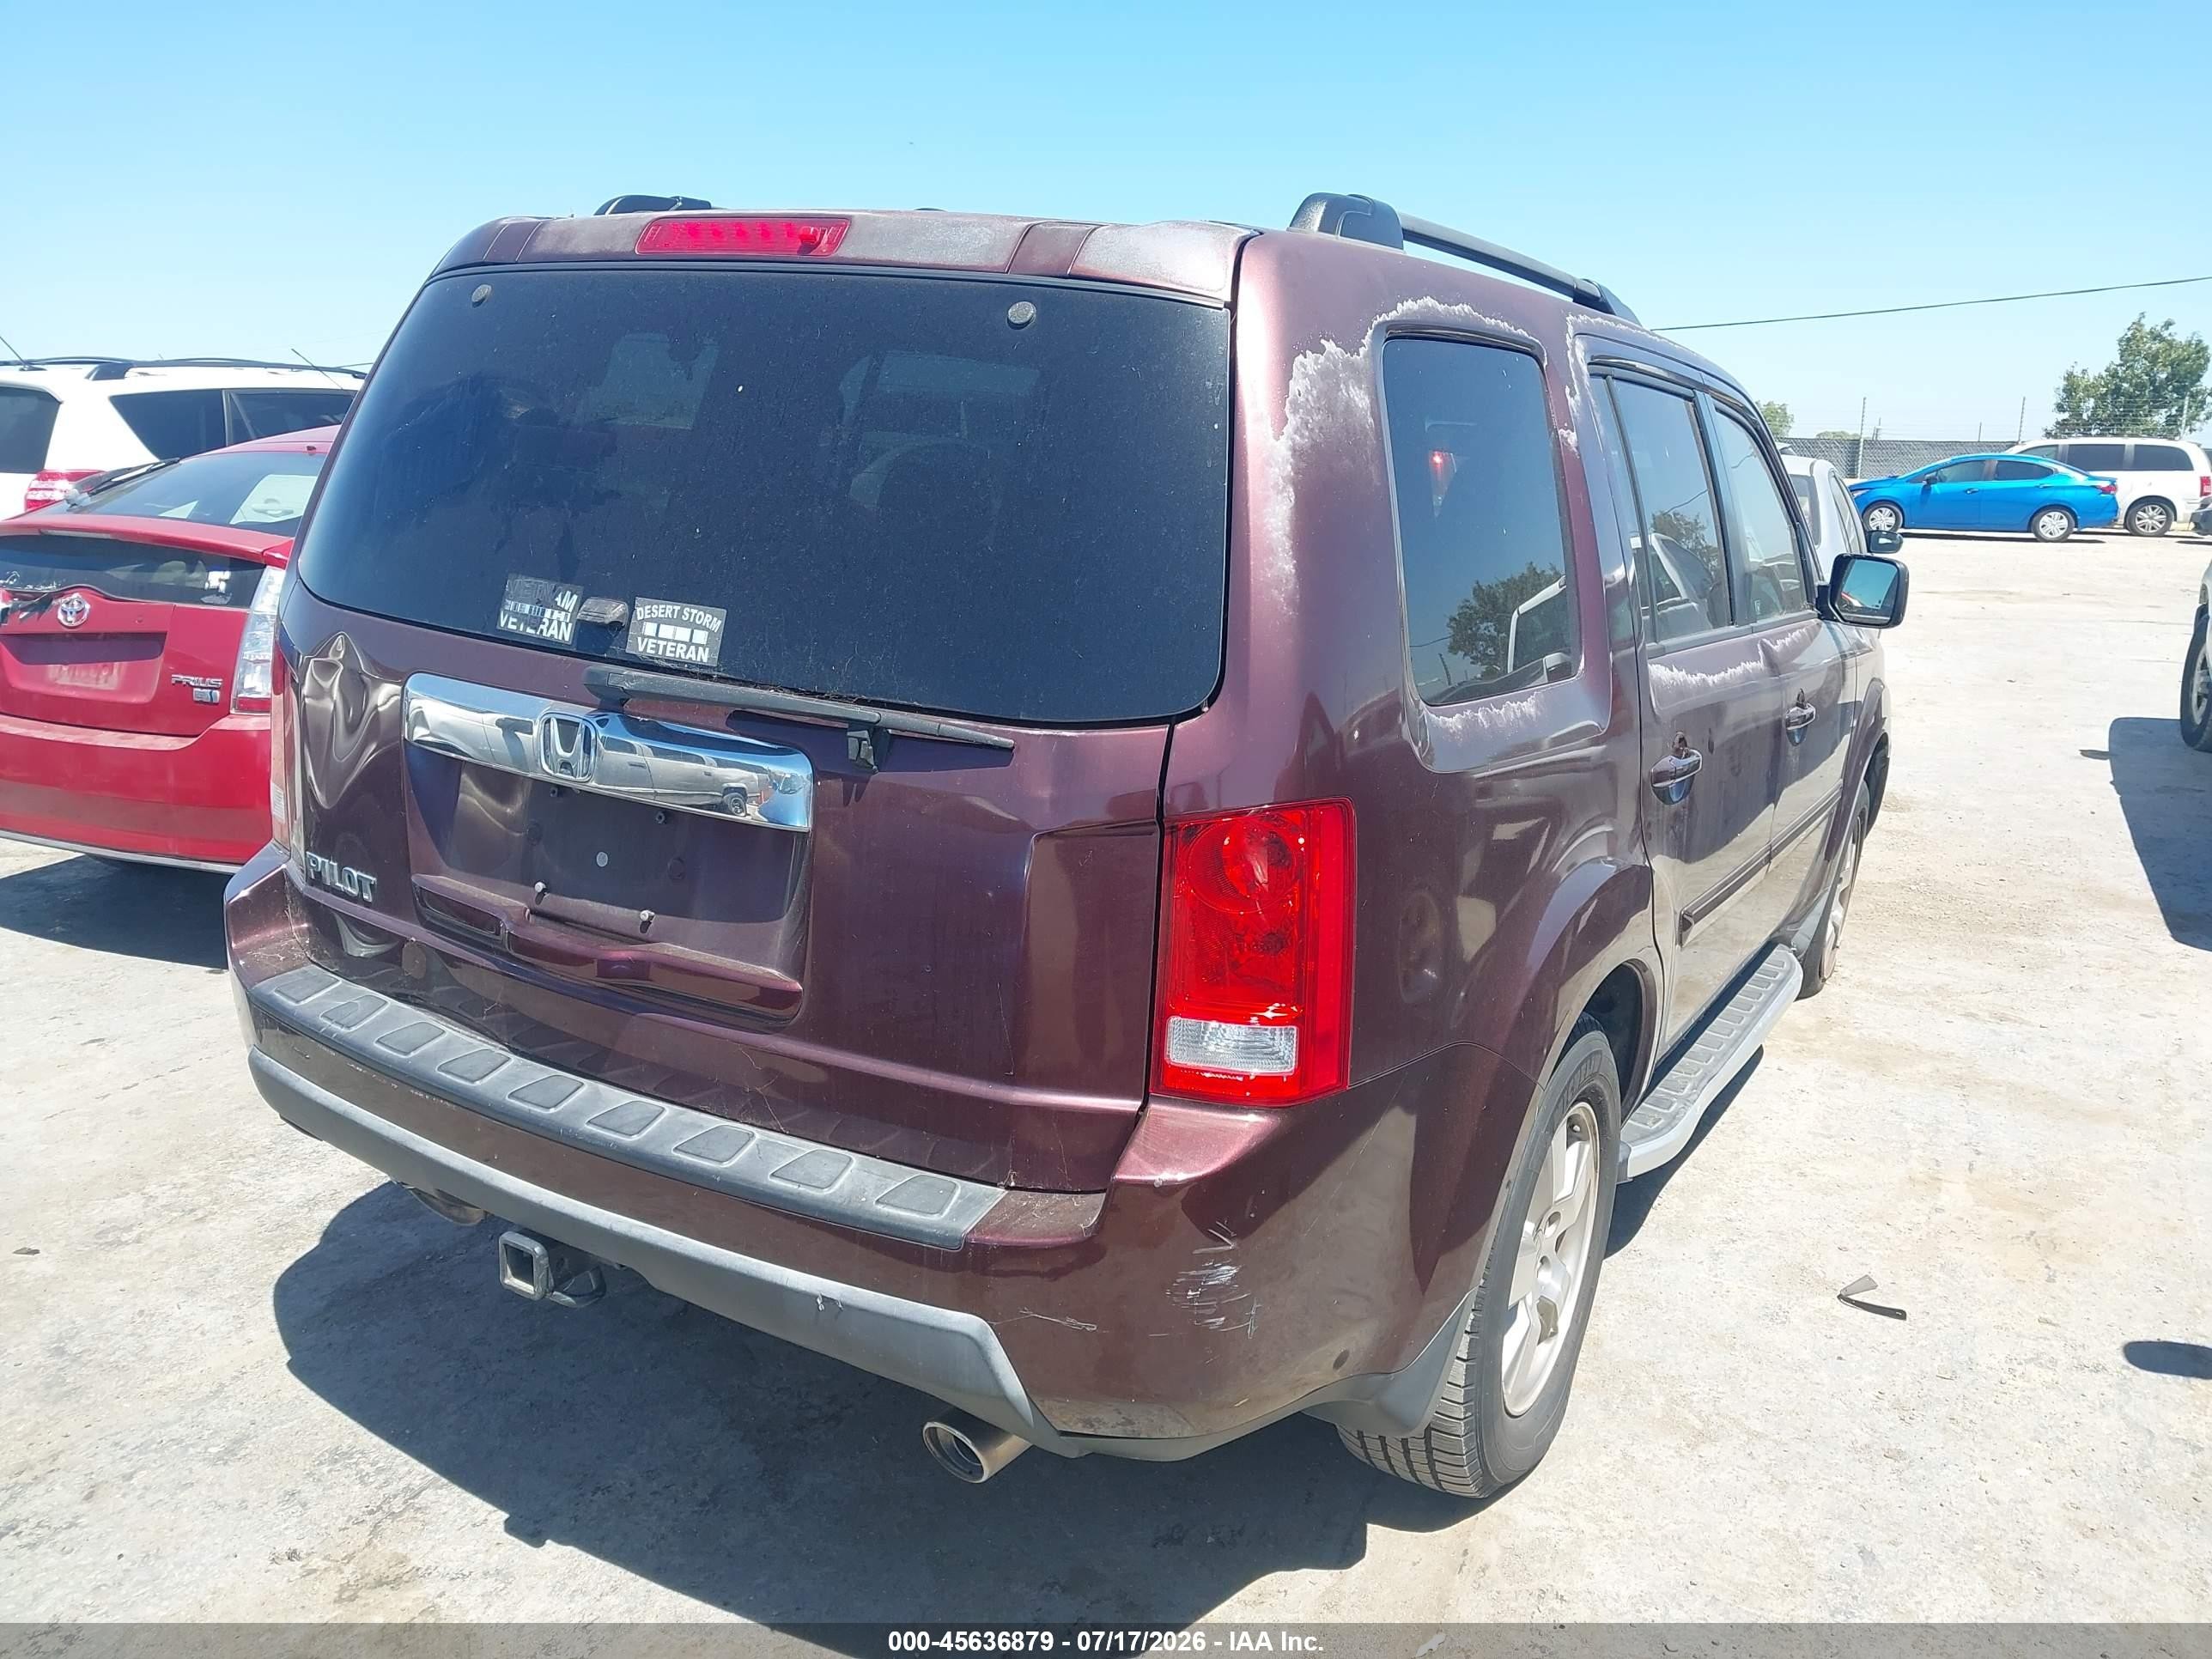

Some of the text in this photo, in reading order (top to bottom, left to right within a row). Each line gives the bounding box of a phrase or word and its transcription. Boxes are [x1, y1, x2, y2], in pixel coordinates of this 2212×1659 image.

[636, 605, 721, 633] DESERT STORM
[637, 637, 709, 663] VETERAN
[306, 851, 377, 902] PILOT
